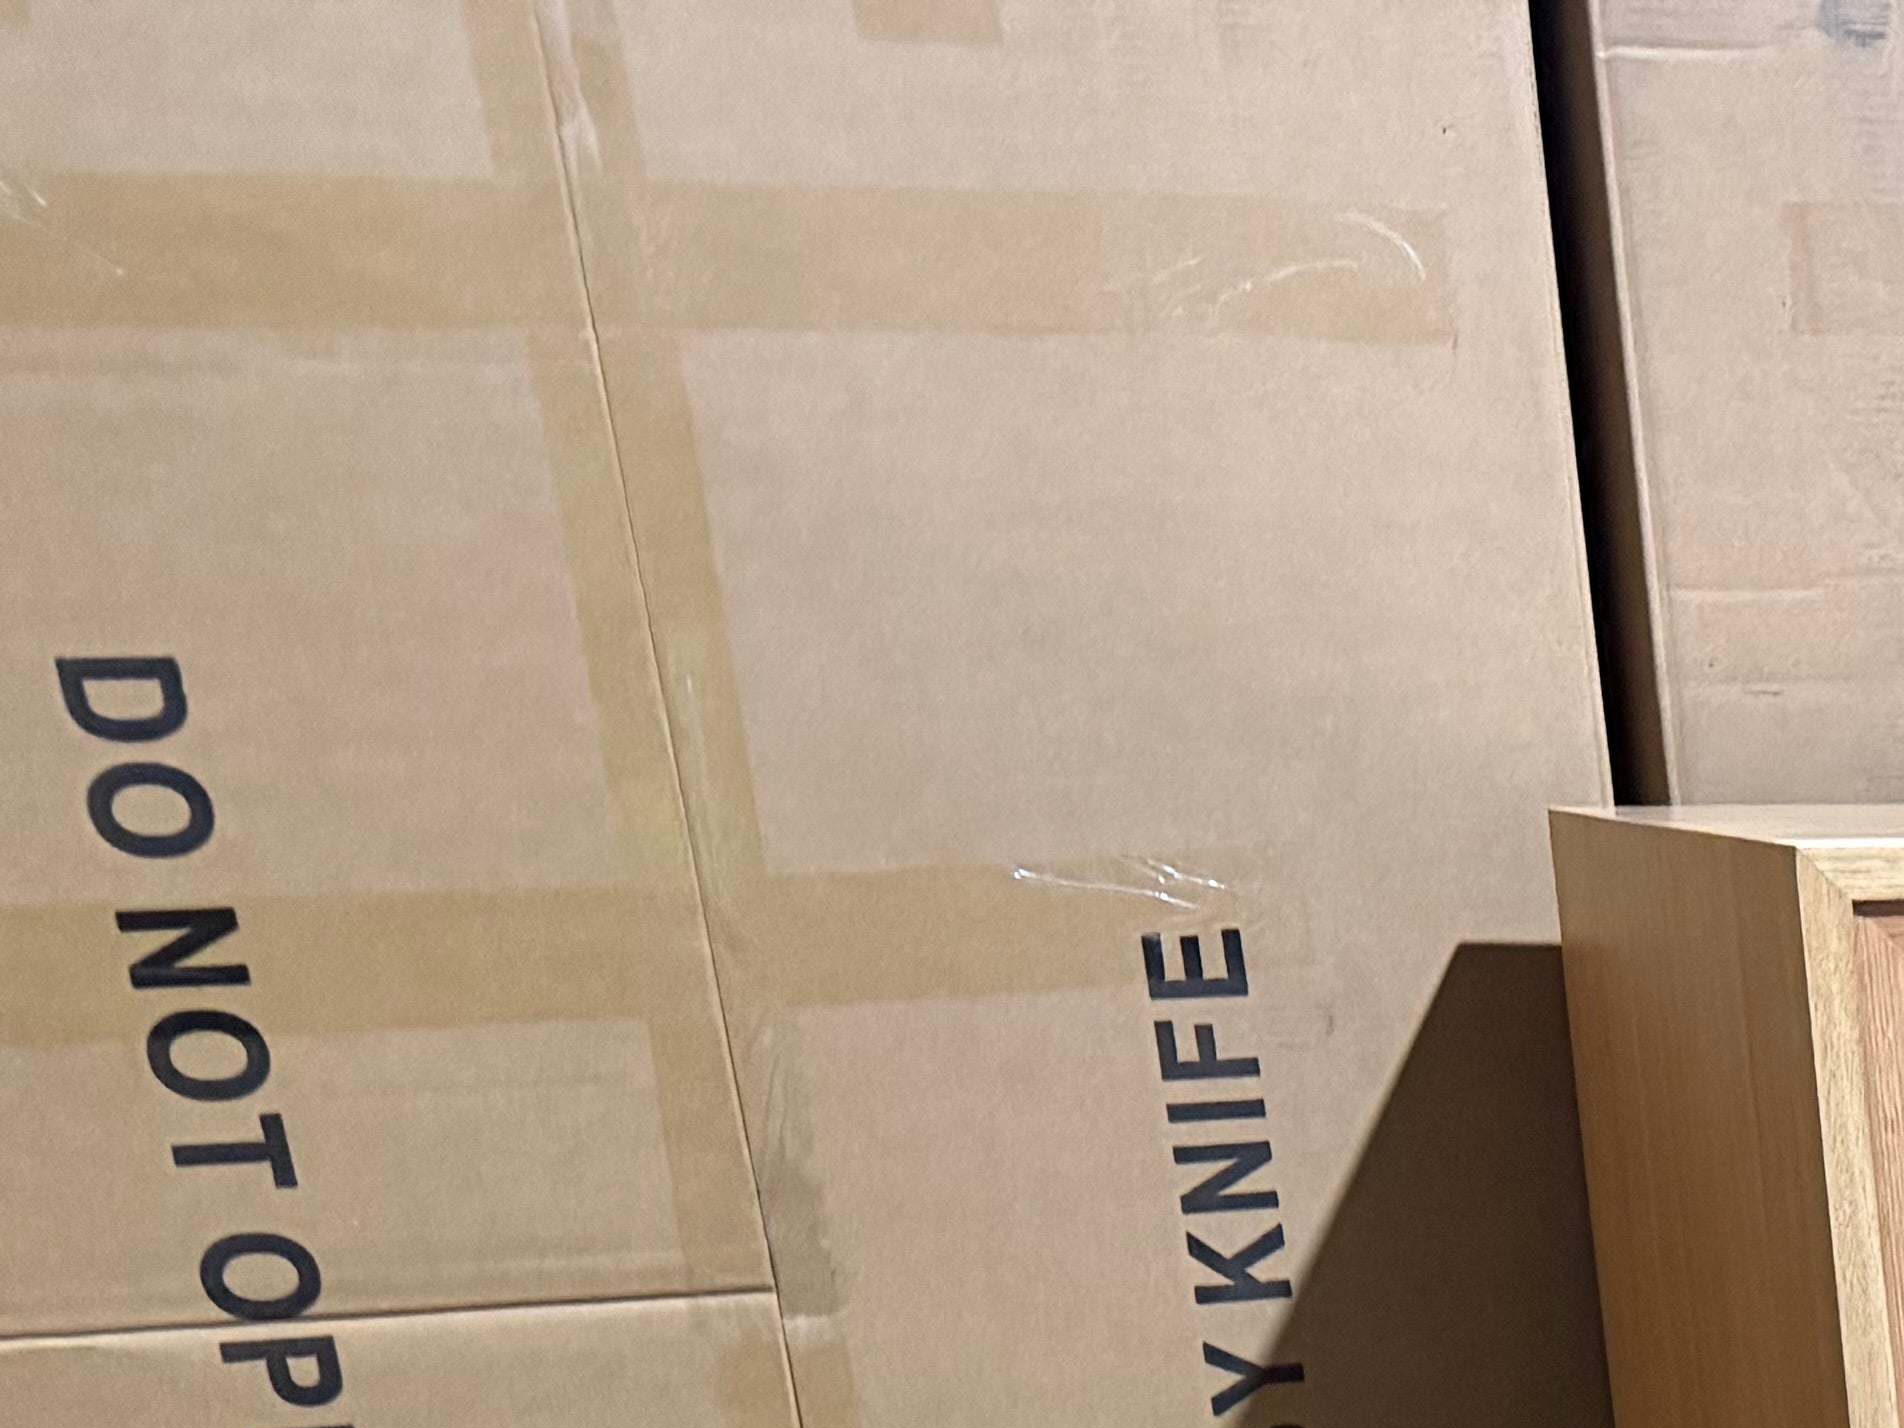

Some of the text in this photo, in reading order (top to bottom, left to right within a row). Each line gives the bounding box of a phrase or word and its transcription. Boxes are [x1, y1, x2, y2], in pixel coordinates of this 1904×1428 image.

[54, 656, 216, 860] DO
[113, 905, 299, 1190] NOT
[1141, 927, 1301, 1306] KNIFE
